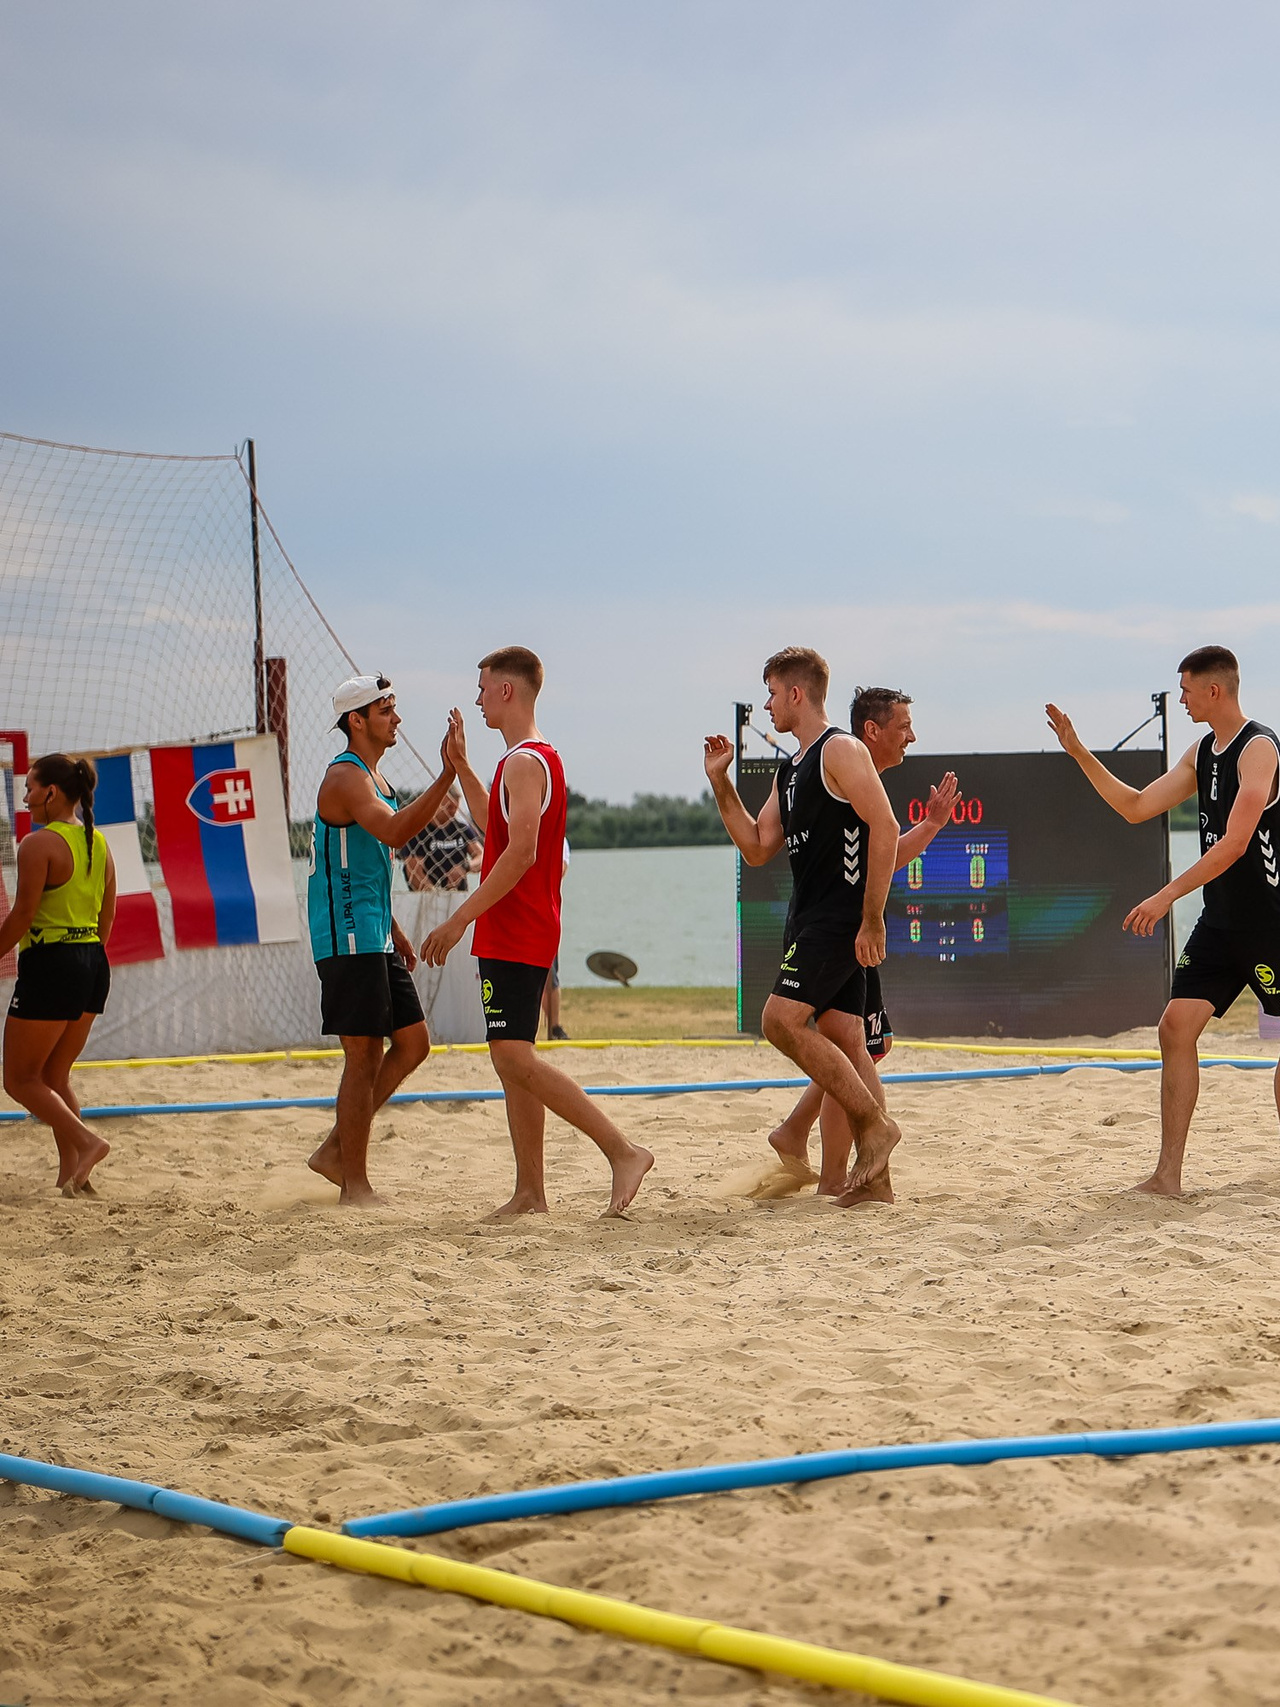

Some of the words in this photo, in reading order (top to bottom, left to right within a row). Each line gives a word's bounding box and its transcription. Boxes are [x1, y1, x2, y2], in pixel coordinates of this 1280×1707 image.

[341, 871, 352, 899] LAKE
[343, 901, 356, 930] LUPA
[782, 978, 800, 989] JAKO
[488, 1020, 507, 1028] JAKO
